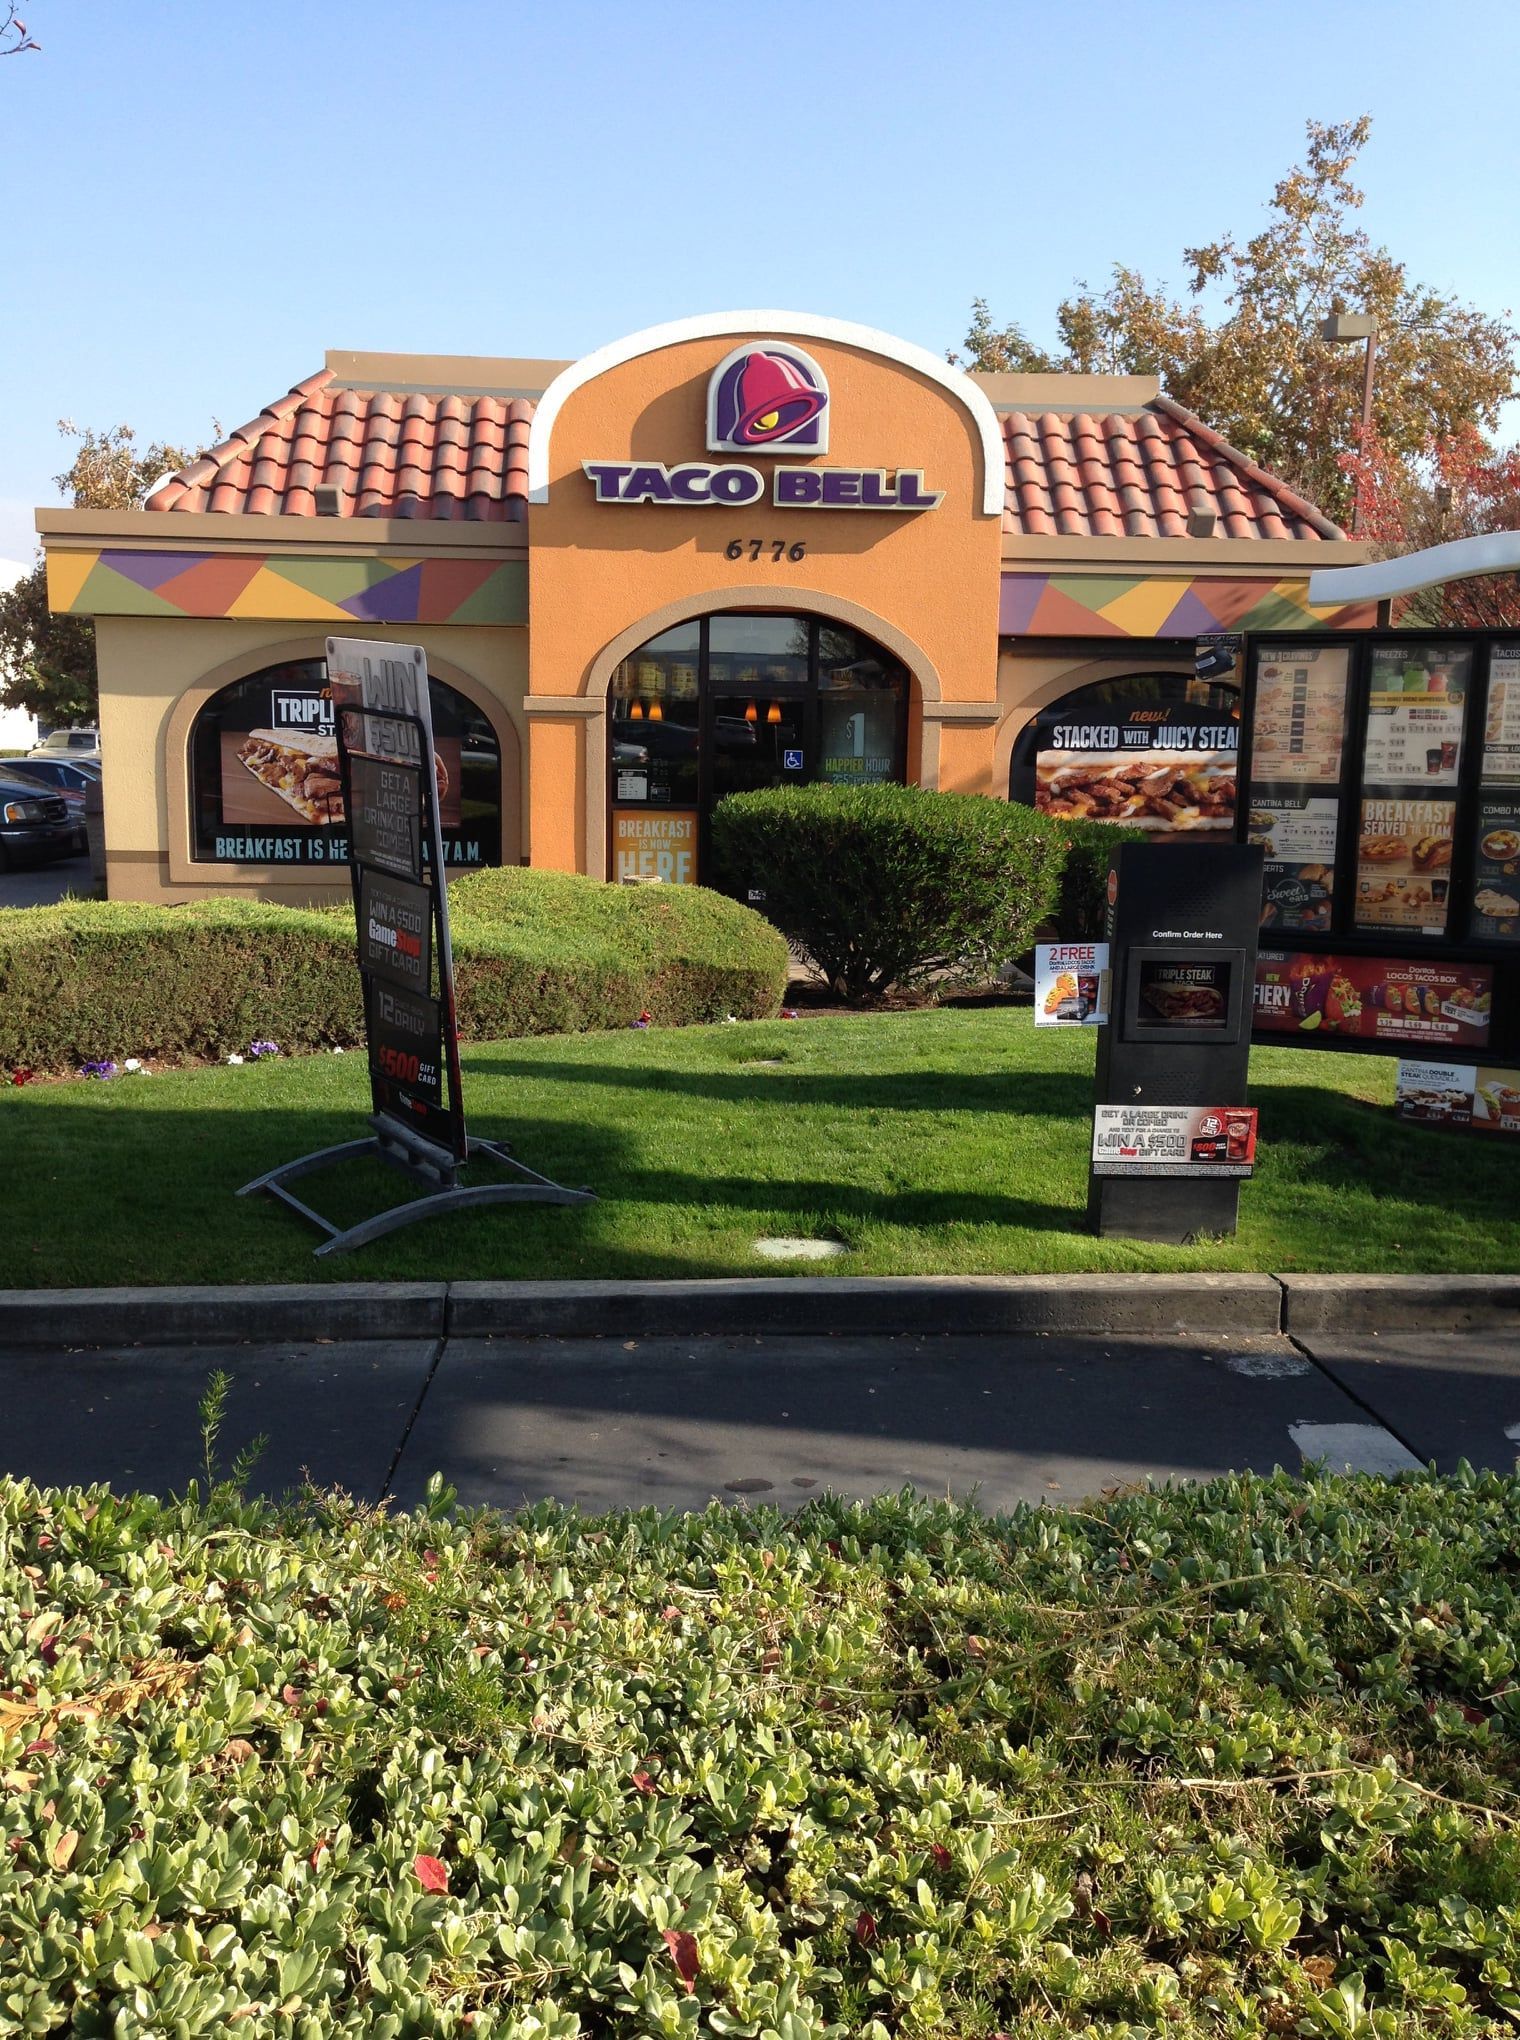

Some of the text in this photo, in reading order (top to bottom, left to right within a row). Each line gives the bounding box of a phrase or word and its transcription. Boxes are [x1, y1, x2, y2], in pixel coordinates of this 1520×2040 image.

[588, 465, 938, 507] TACO BELL
[725, 539, 806, 563] 6776
[1375, 650, 1408, 659] FREEZES
[363, 657, 419, 712] WIN
[1129, 708, 1171, 722] new!
[1053, 725, 1119, 749] STACKED
[1123, 730, 1149, 745] WITH
[1152, 725, 1197, 749] JUICY
[825, 758, 891, 772] HAPPIER HOUR
[381, 771, 411, 794] GET A
[376, 790, 411, 814] LARGE
[1252, 799, 1302, 808] CANTINA BELL
[1365, 801, 1453, 823] BREAKFAST
[1483, 806, 1511, 815] COMBO
[364, 807, 394, 830] DRINK
[618, 820, 692, 838] BREAKFAST
[1364, 821, 1407, 836] SERVED
[215, 837, 302, 860] BREAKFAST
[308, 838, 323, 860] IS
[329, 838, 348, 860] HE
[639, 839, 672, 850] IS NOW
[618, 850, 692, 884] HERE
[369, 899, 422, 933] WIN A $500
[368, 918, 421, 958] GameStop
[1152, 930, 1223, 939] Confirm Order Here
[368, 942, 420, 977] GIFT CARD
[1049, 946, 1096, 960] 2 FREE
[1159, 968, 1213, 981] TRIPLE STEAK
[1386, 972, 1457, 984] LOCOS TACOS BOX
[1408, 966, 1436, 975] Doritos
[1253, 984, 1292, 1007] FIERY
[379, 991, 395, 1025] 12
[395, 1009, 425, 1037] DAILY
[379, 1044, 419, 1084] $500
[419, 1062, 435, 1075] GIFT
[1401, 1066, 1455, 1077] CANTINA DOUBLE
[417, 1073, 437, 1086] CARD
[1101, 1110, 1189, 1120] GET A LARGE DRINK
[1122, 1118, 1168, 1127] OR COMBO
[1206, 1117, 1219, 1128] 12
[1098, 1133, 1188, 1149] WIN A $500
[1138, 1148, 1160, 1157] GIFT
[1160, 1149, 1186, 1157] CARD
